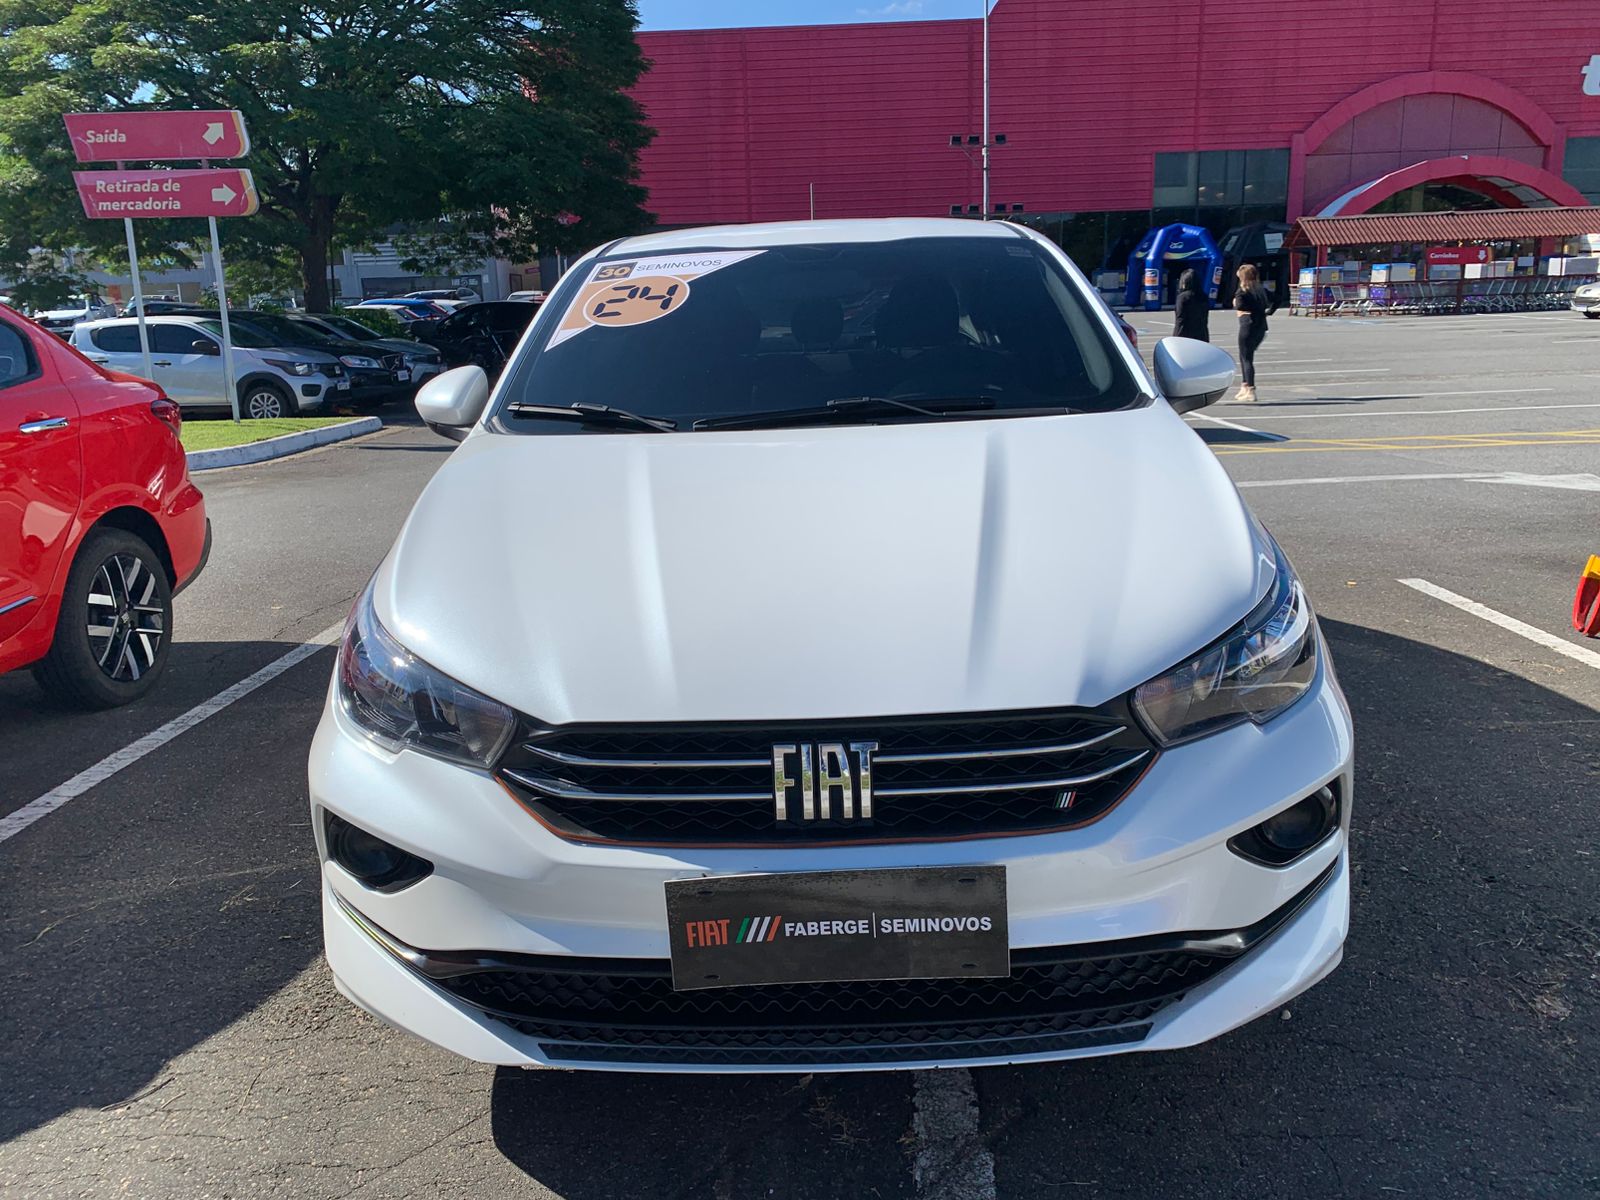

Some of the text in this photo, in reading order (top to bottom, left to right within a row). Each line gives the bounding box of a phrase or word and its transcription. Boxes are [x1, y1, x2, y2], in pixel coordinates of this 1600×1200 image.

[86, 129, 127, 144] Saída
[95, 179, 181, 193] Retirada de
[98, 196, 181, 211] mercadoria
[598, 259, 722, 278] 30 SEMINOVOS
[592, 283, 678, 318] 24
[771, 741, 880, 822] FIAT
[685, 916, 993, 949] FIAT FABERGE SEMINOVOS
